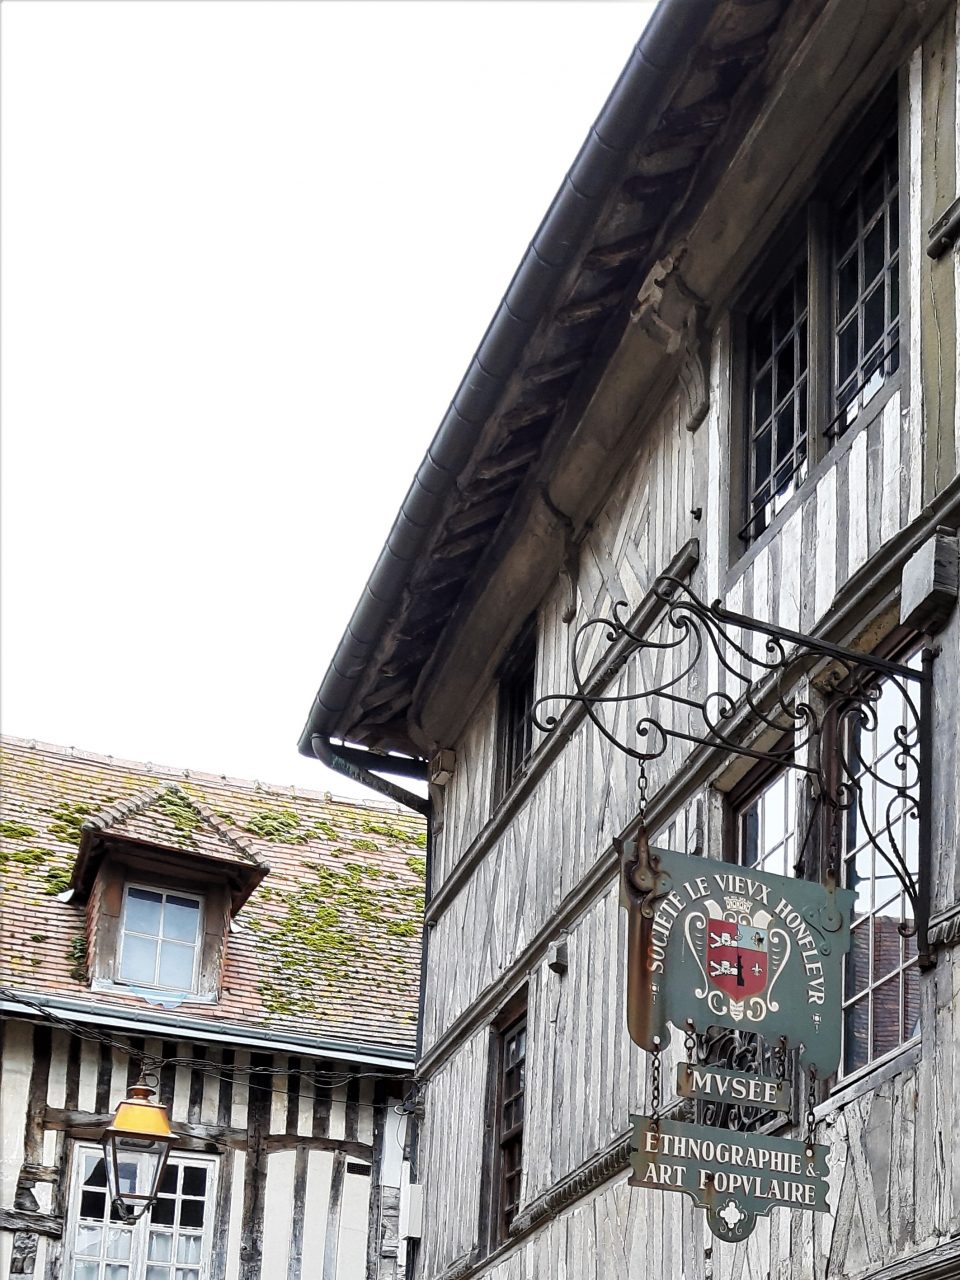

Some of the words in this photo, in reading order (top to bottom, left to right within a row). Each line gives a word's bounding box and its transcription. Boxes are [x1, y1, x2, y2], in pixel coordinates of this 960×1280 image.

[682, 876, 711, 901] LE
[713, 874, 772, 906] VIEVX
[774, 897, 826, 1006] HONFLEVR
[642, 1162, 687, 1187] ART
[644, 1131, 802, 1175] ETHNOGRAPHIE
